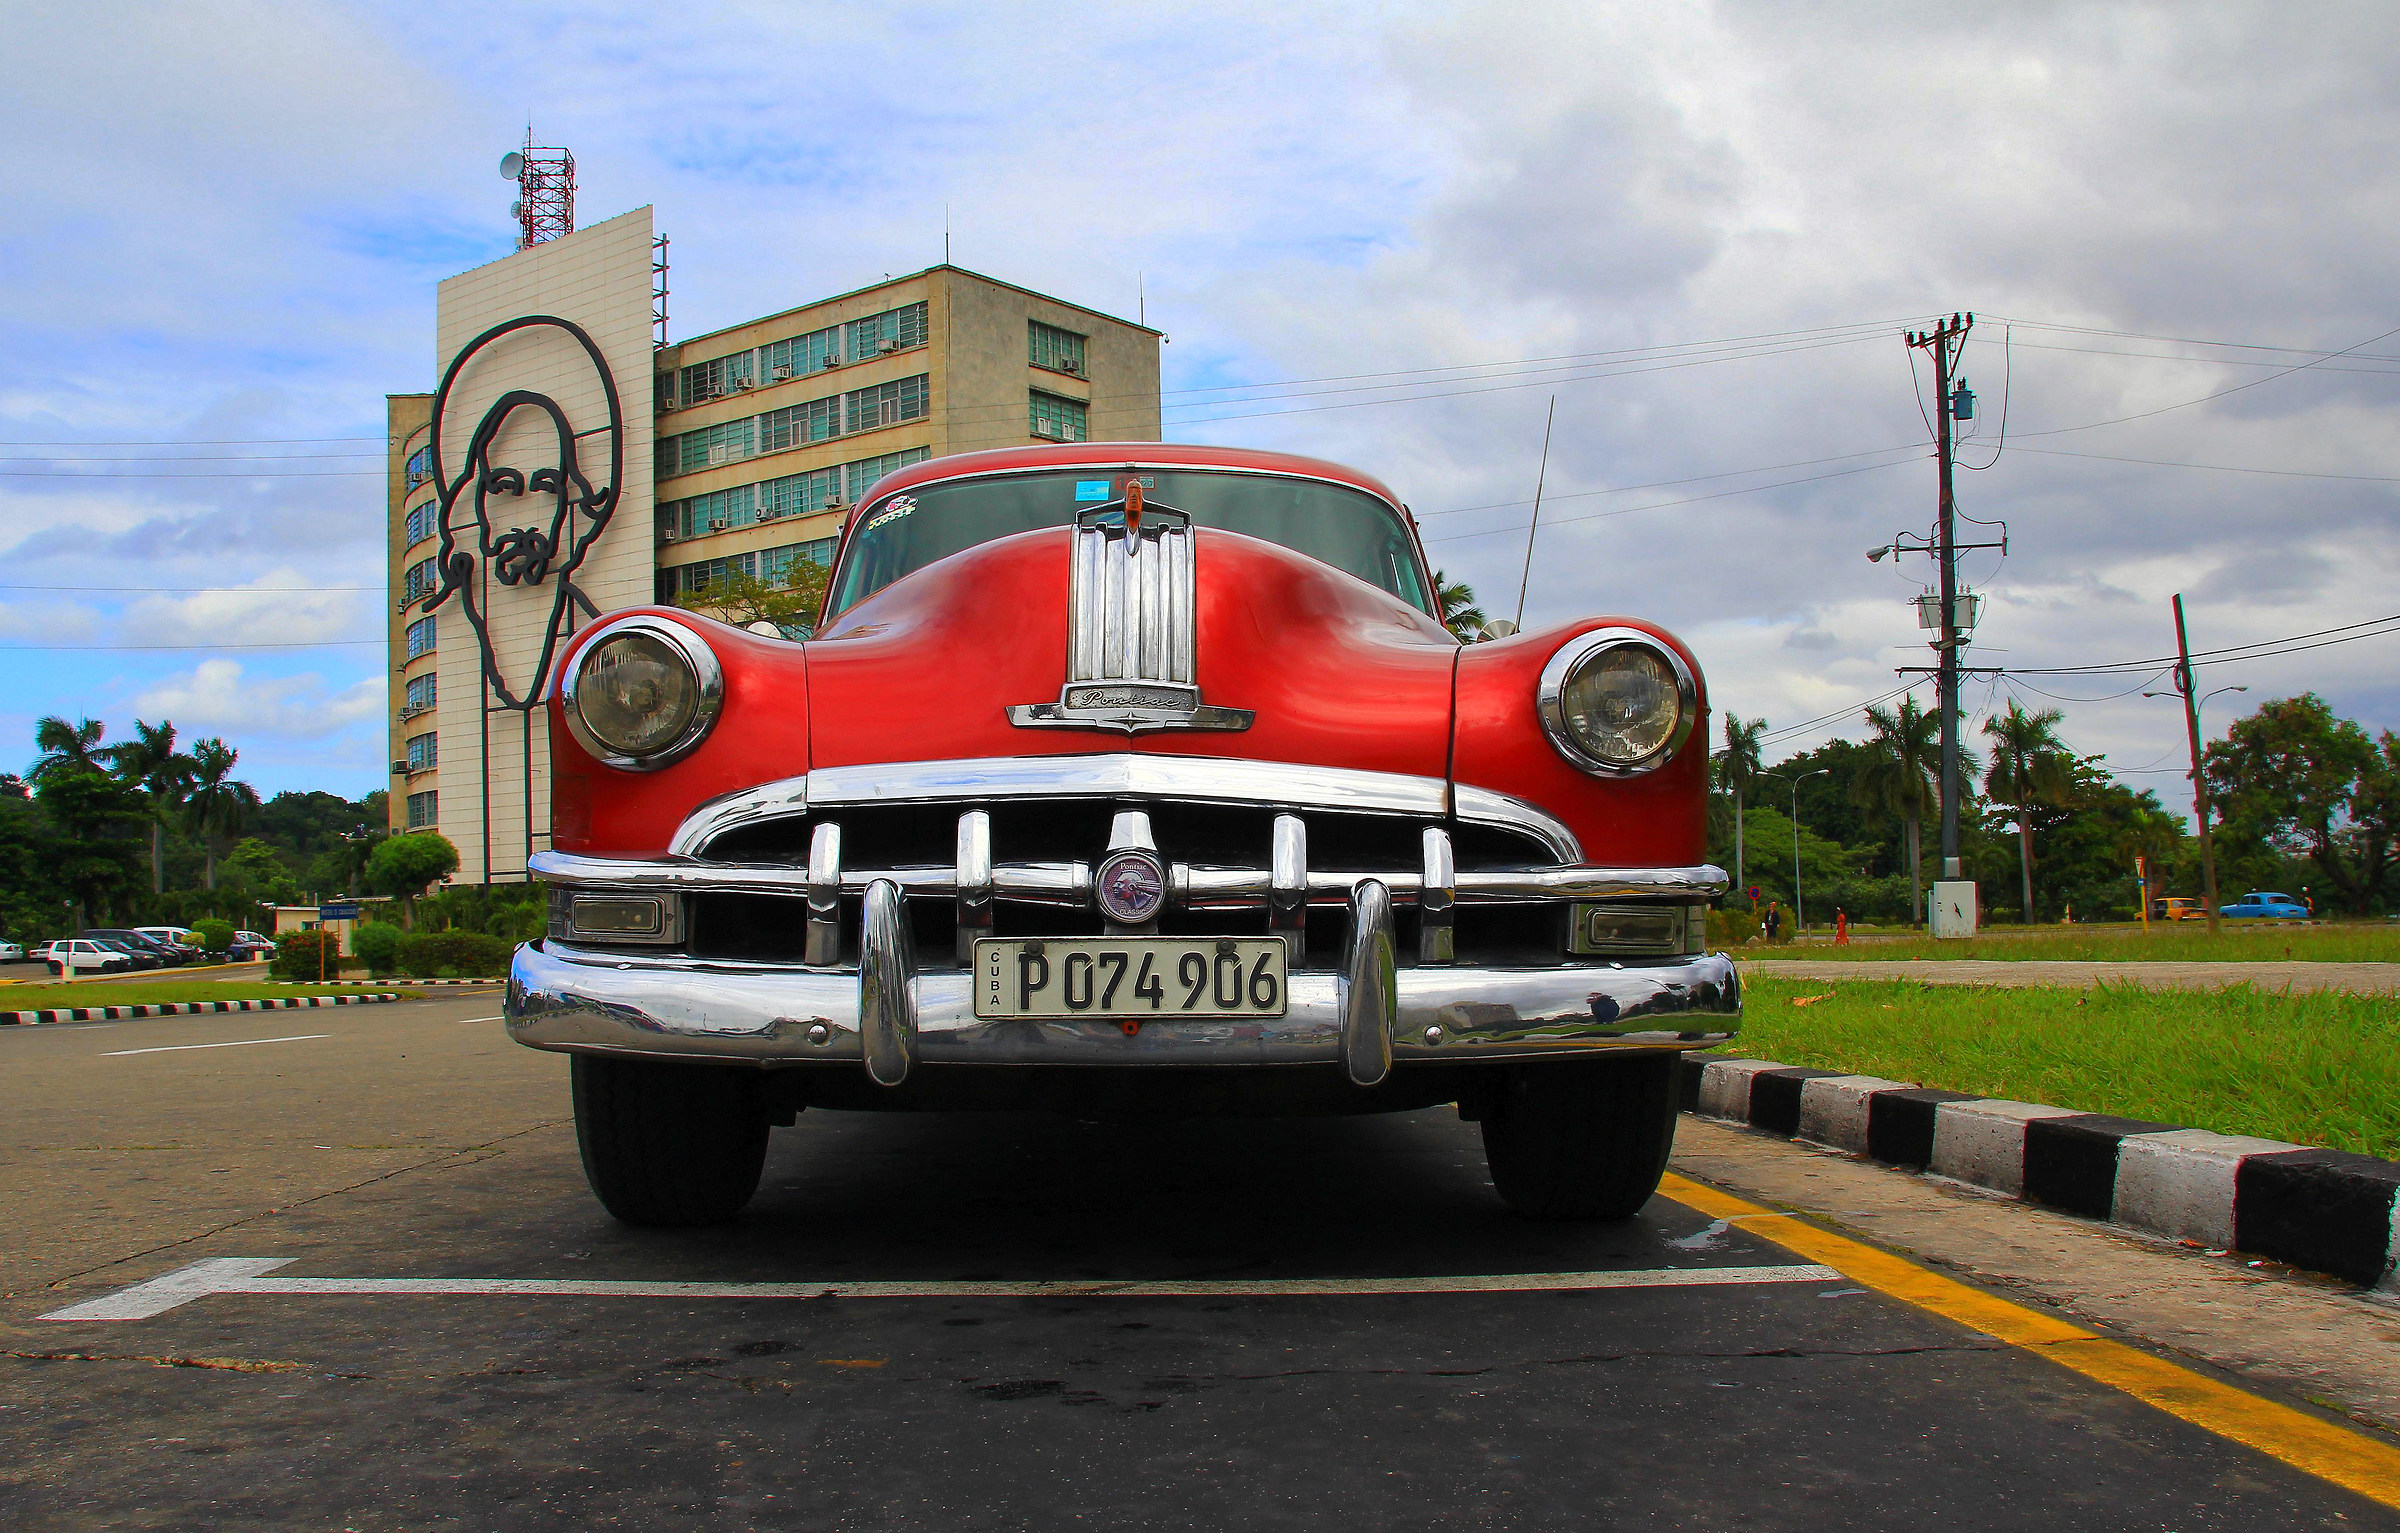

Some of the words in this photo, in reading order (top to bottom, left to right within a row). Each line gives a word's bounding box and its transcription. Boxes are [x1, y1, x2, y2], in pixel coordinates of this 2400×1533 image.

[1081, 690, 1181, 706] Pontiac
[1120, 862, 1147, 870] Pontiac
[990, 951, 1000, 1005] CUBA
